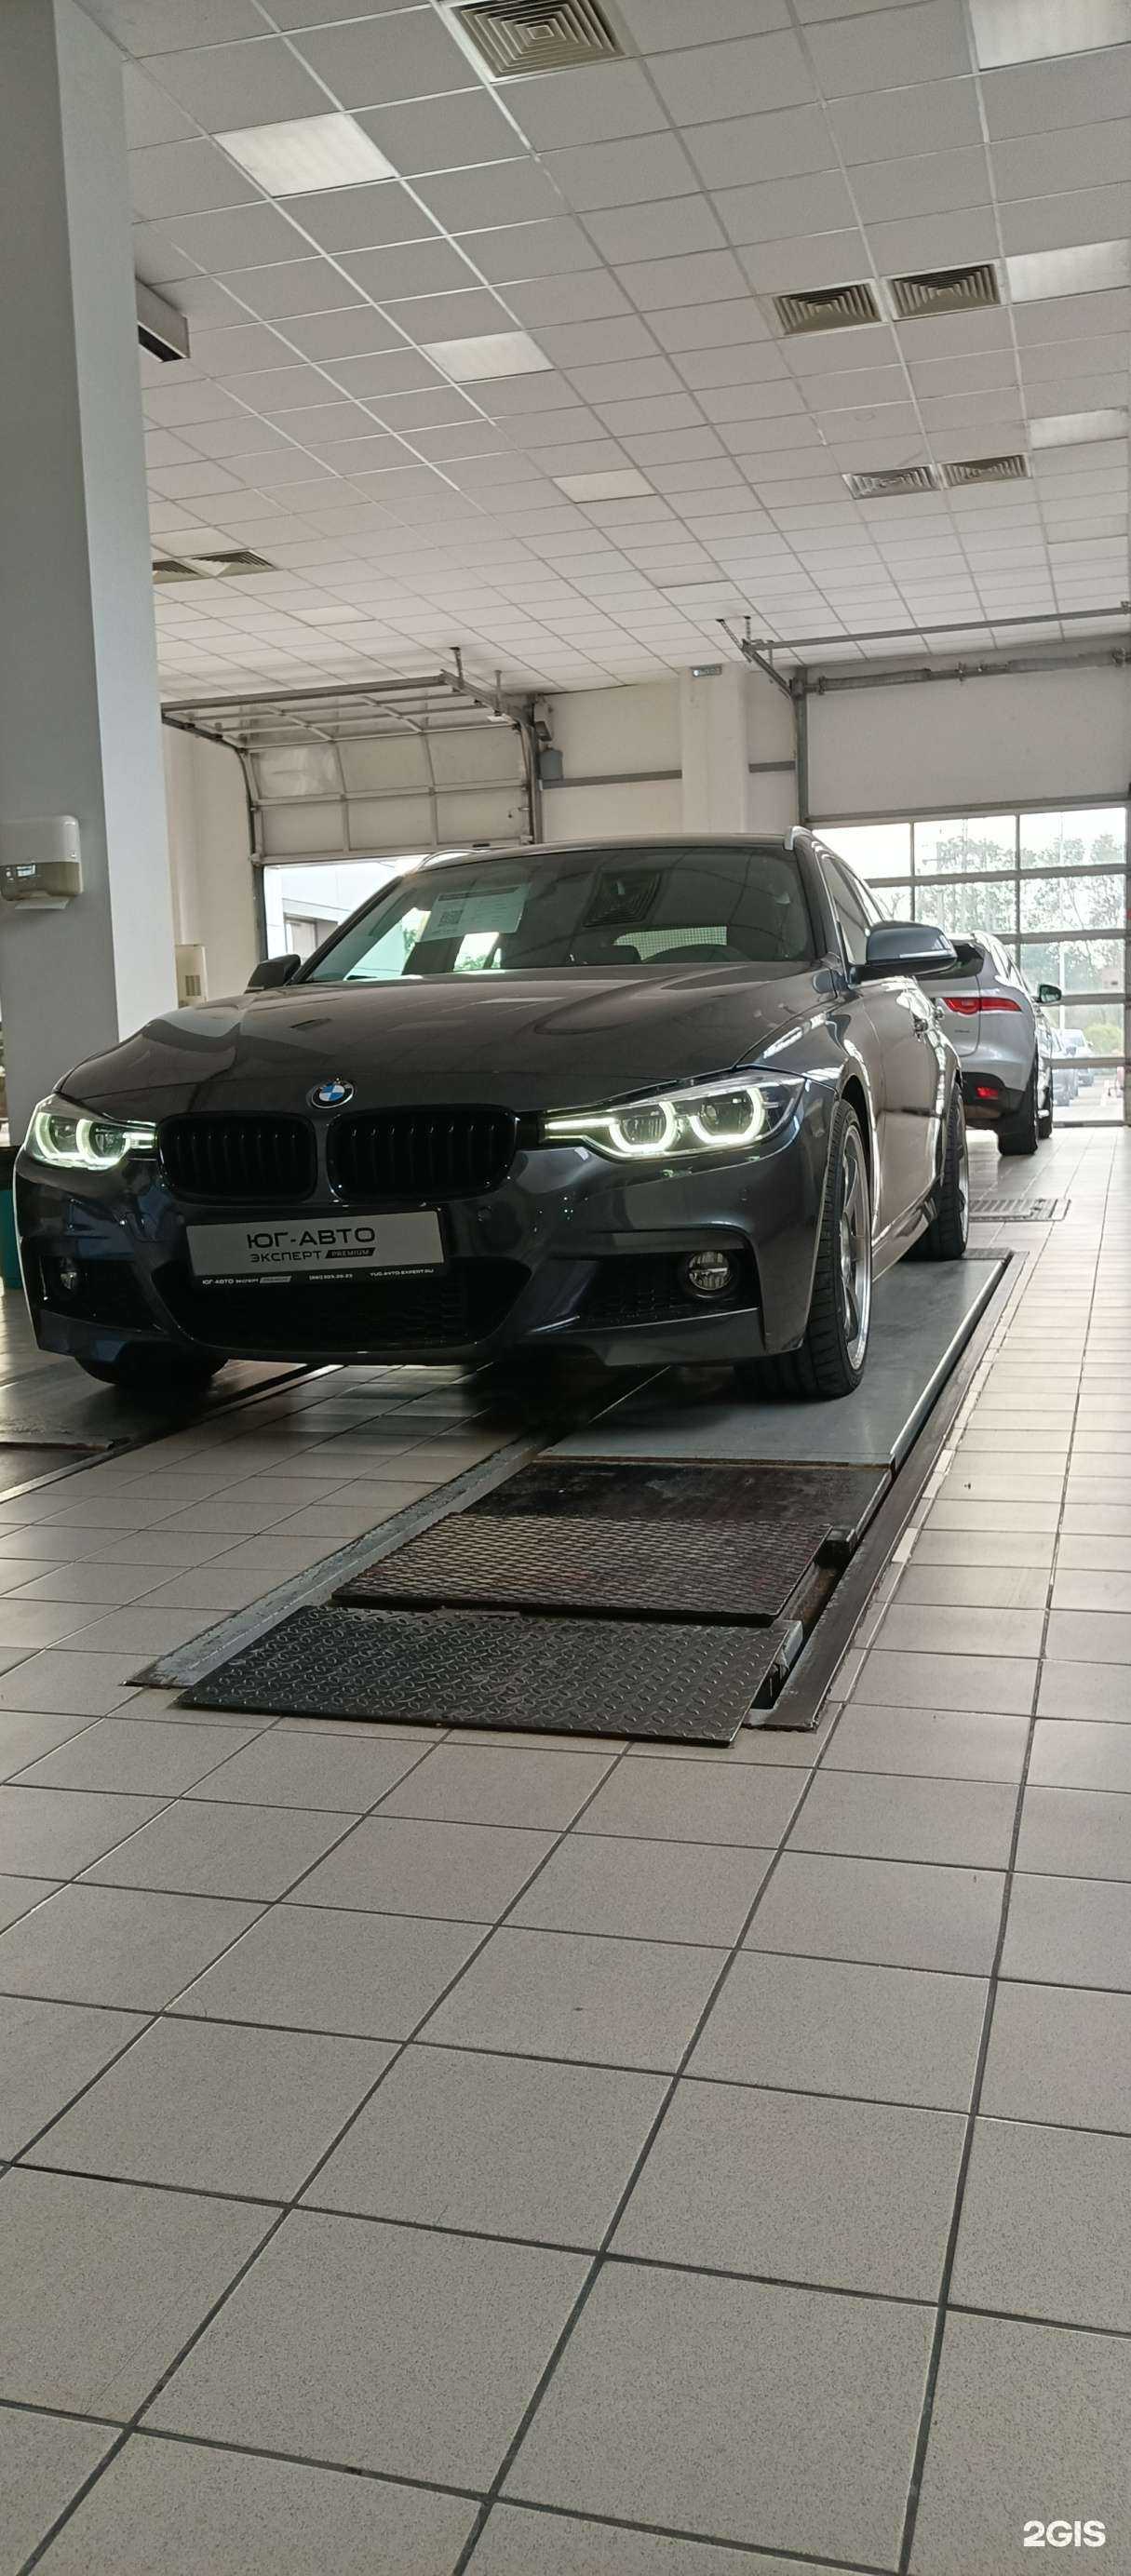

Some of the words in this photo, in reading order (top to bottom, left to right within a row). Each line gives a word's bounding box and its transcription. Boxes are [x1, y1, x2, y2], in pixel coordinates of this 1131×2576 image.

[247, 1227, 375, 1249] ЮГ-АВТО
[250, 1250, 322, 1263] ЭКСПЕРТ
[330, 1248, 370, 1258] PREMIUM
